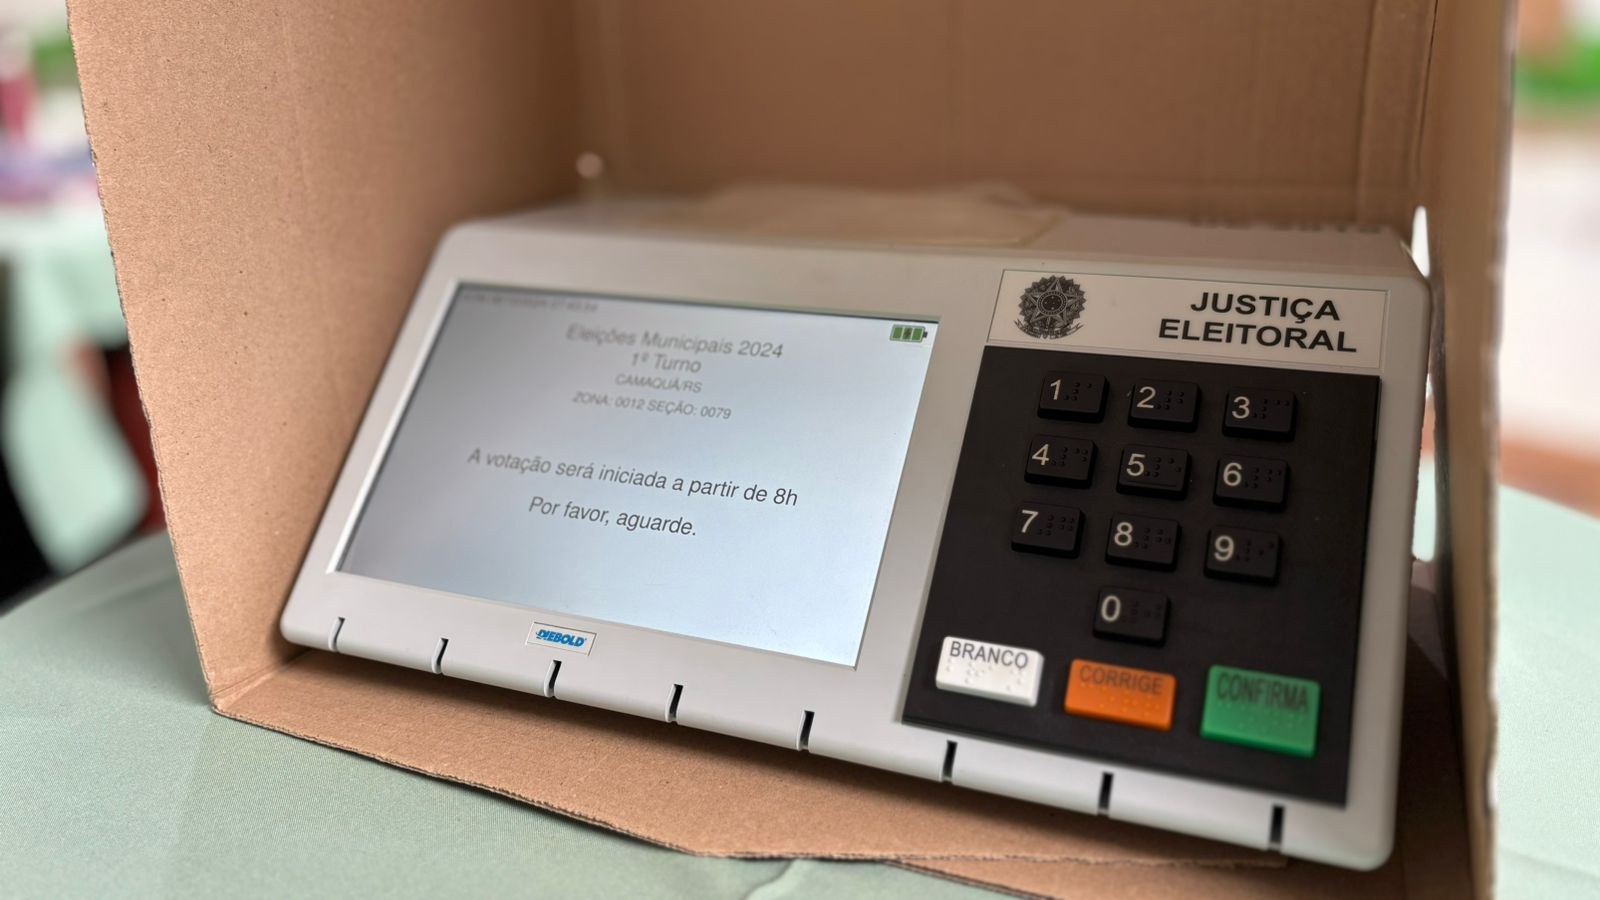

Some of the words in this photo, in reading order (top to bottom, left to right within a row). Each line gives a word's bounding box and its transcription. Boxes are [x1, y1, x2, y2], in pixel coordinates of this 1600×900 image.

[1190, 291, 1340, 323] JUSTIÇA
[566, 323, 636, 347] Eleições
[640, 330, 733, 354] Municipais
[737, 341, 784, 358] 2024
[1158, 318, 1357, 353] ELEITORAL
[631, 352, 649, 366] 1º
[654, 353, 701, 373] Turno
[1050, 379, 1062, 401] 1
[1136, 386, 1157, 409] 2
[572, 391, 612, 405] ZONA:
[615, 396, 645, 411] 0012
[648, 398, 697, 416] SEÇÃO:
[700, 405, 732, 420] 0079
[1231, 396, 1251, 419] 3
[1032, 443, 1050, 466] 4
[1126, 453, 1146, 477] 5
[467, 448, 482, 464] A
[486, 453, 552, 475] votação
[555, 461, 595, 479] será
[598, 464, 667, 489] iniciada
[672, 478, 684, 491] a
[687, 478, 740, 498] partir
[743, 484, 768, 502] de
[773, 488, 798, 507] 8h
[1222, 462, 1243, 486] 6
[528, 496, 560, 516] Por
[563, 501, 610, 526] favor,
[615, 511, 697, 536] aguarde.
[1020, 509, 1039, 533] 7
[1113, 521, 1133, 547] 8
[1213, 535, 1235, 562] 9
[1100, 595, 1121, 622] 0
[536, 629, 585, 647] DIEBOLD
[949, 641, 1029, 669] BRANCO
[1079, 665, 1164, 694] CORRIGE
[1216, 674, 1310, 711] CONFIRMA
